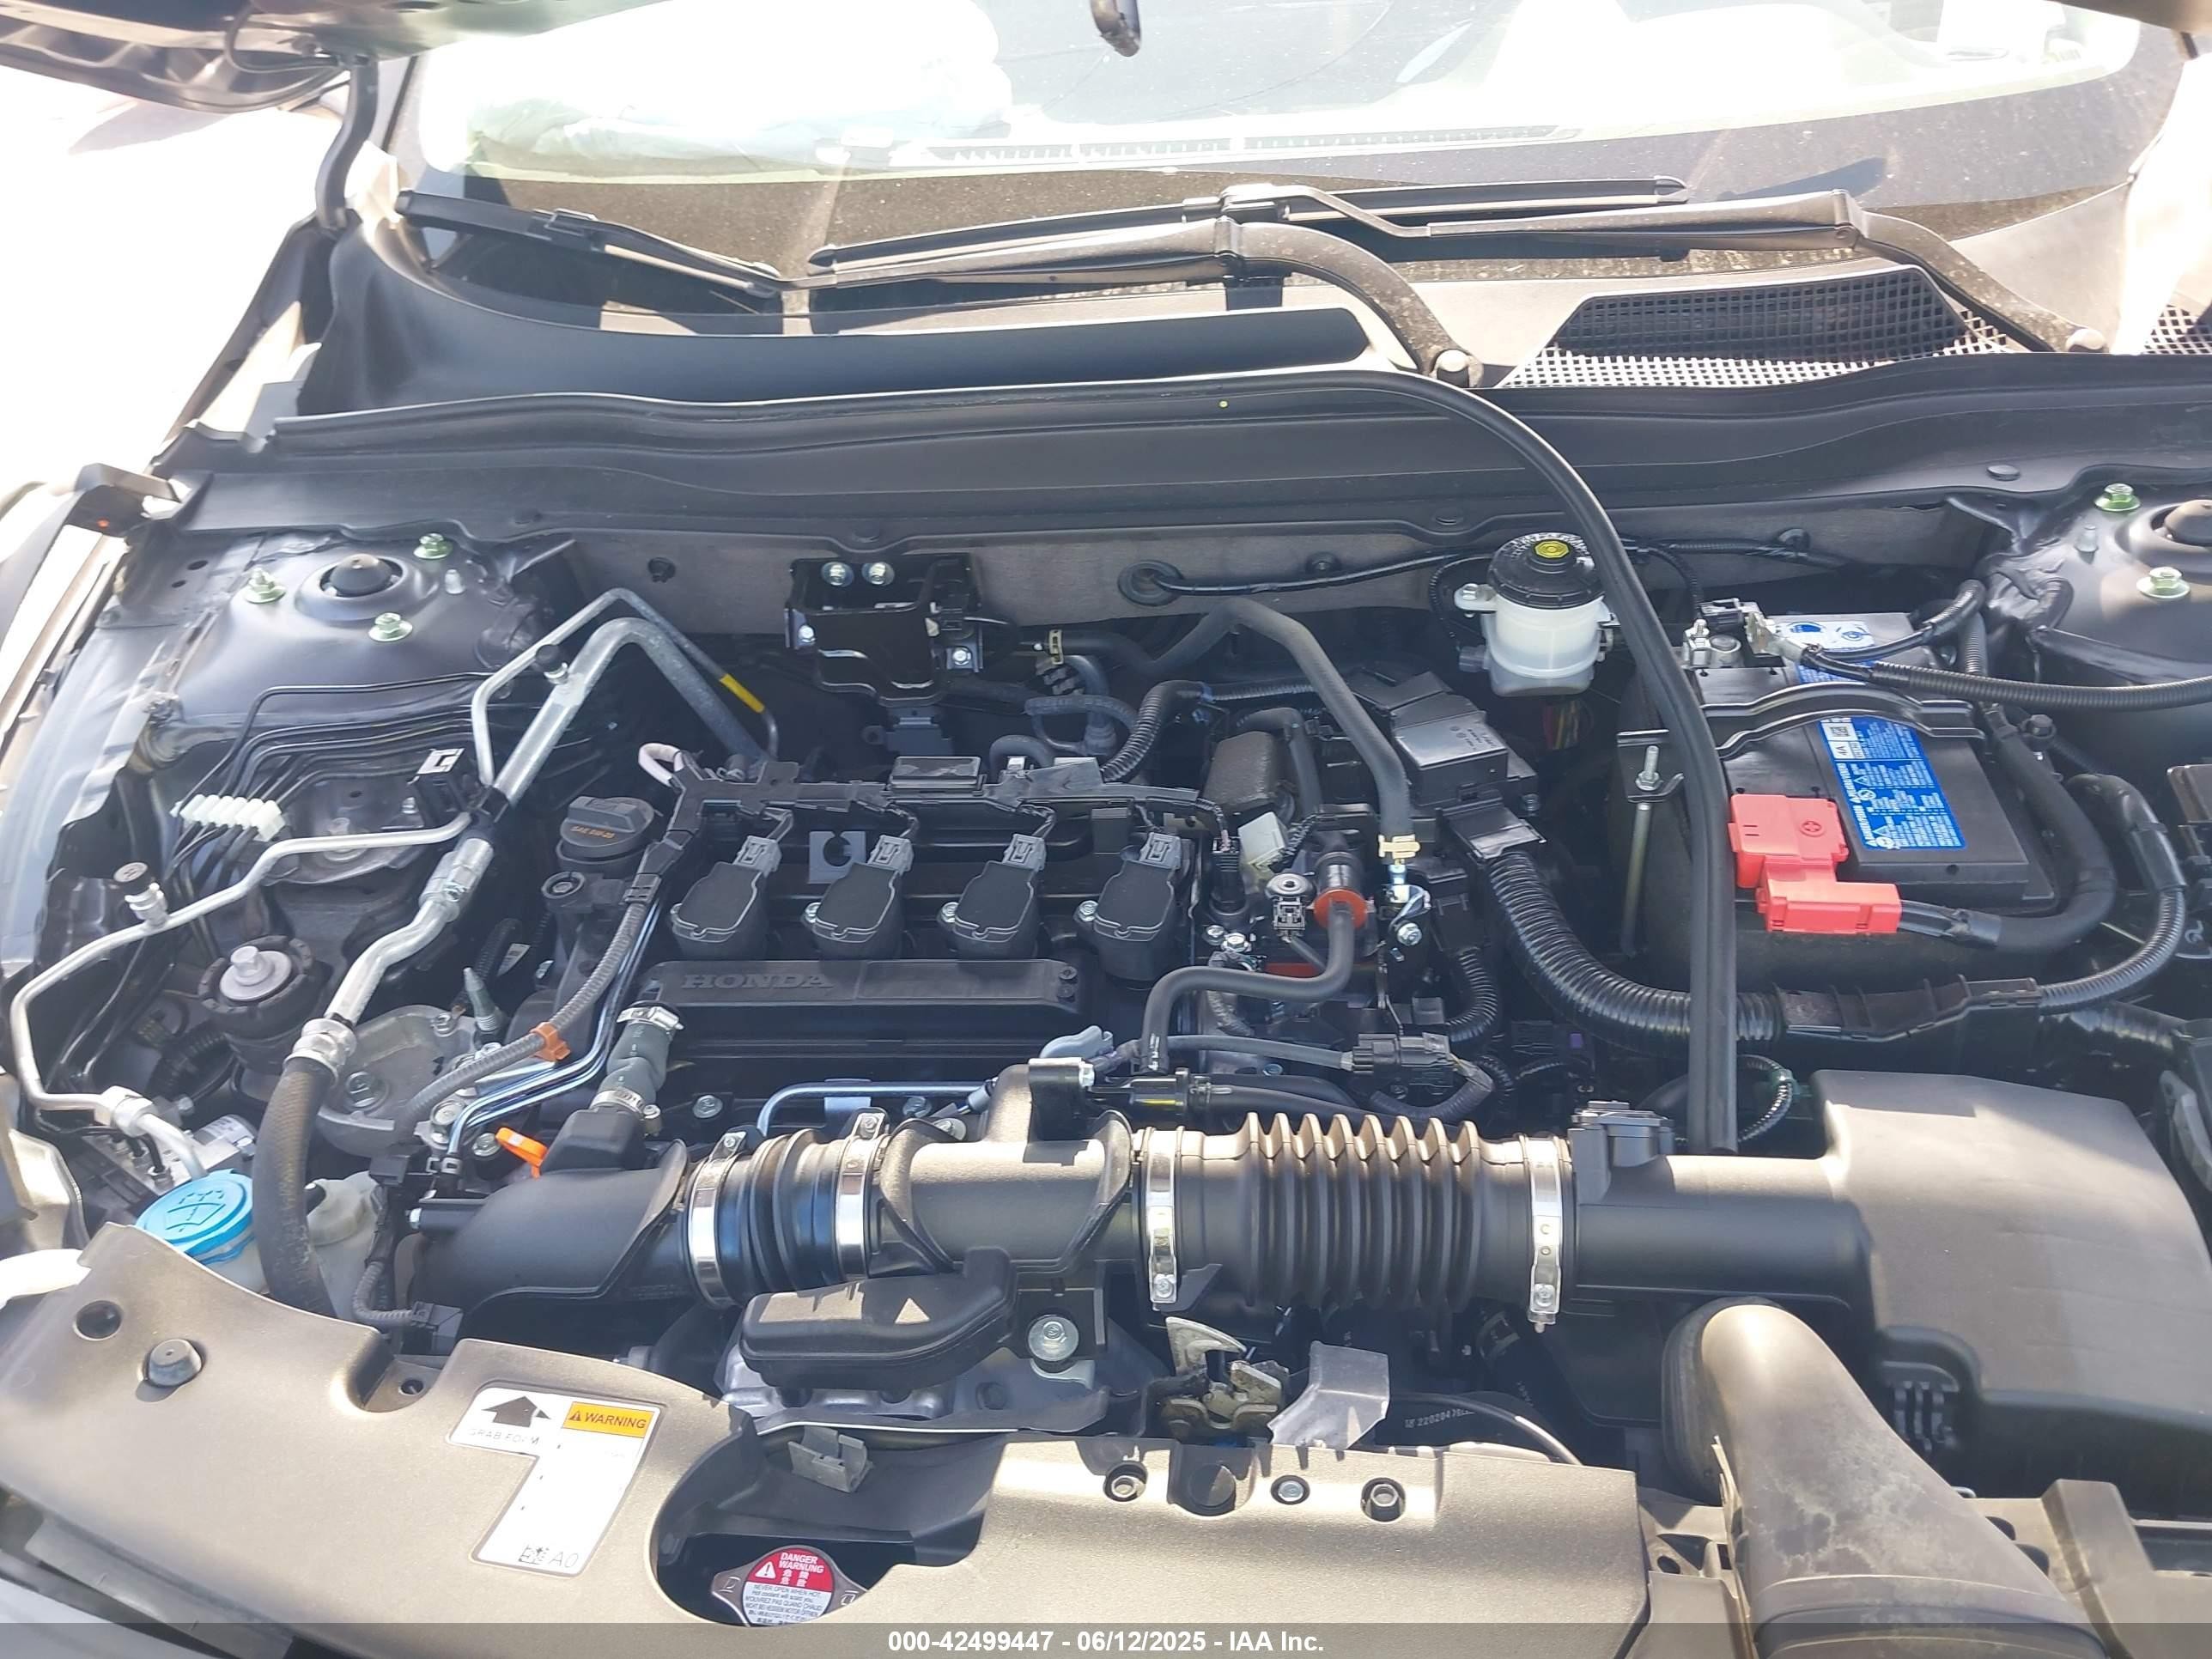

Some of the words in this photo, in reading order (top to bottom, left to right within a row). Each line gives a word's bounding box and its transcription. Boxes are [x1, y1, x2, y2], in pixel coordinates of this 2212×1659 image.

[681, 974, 834, 989] HONDA
[584, 1413, 647, 1429] WARNING
[780, 1553, 818, 1565] DANGER
[778, 1560, 824, 1574] WARNUNG
